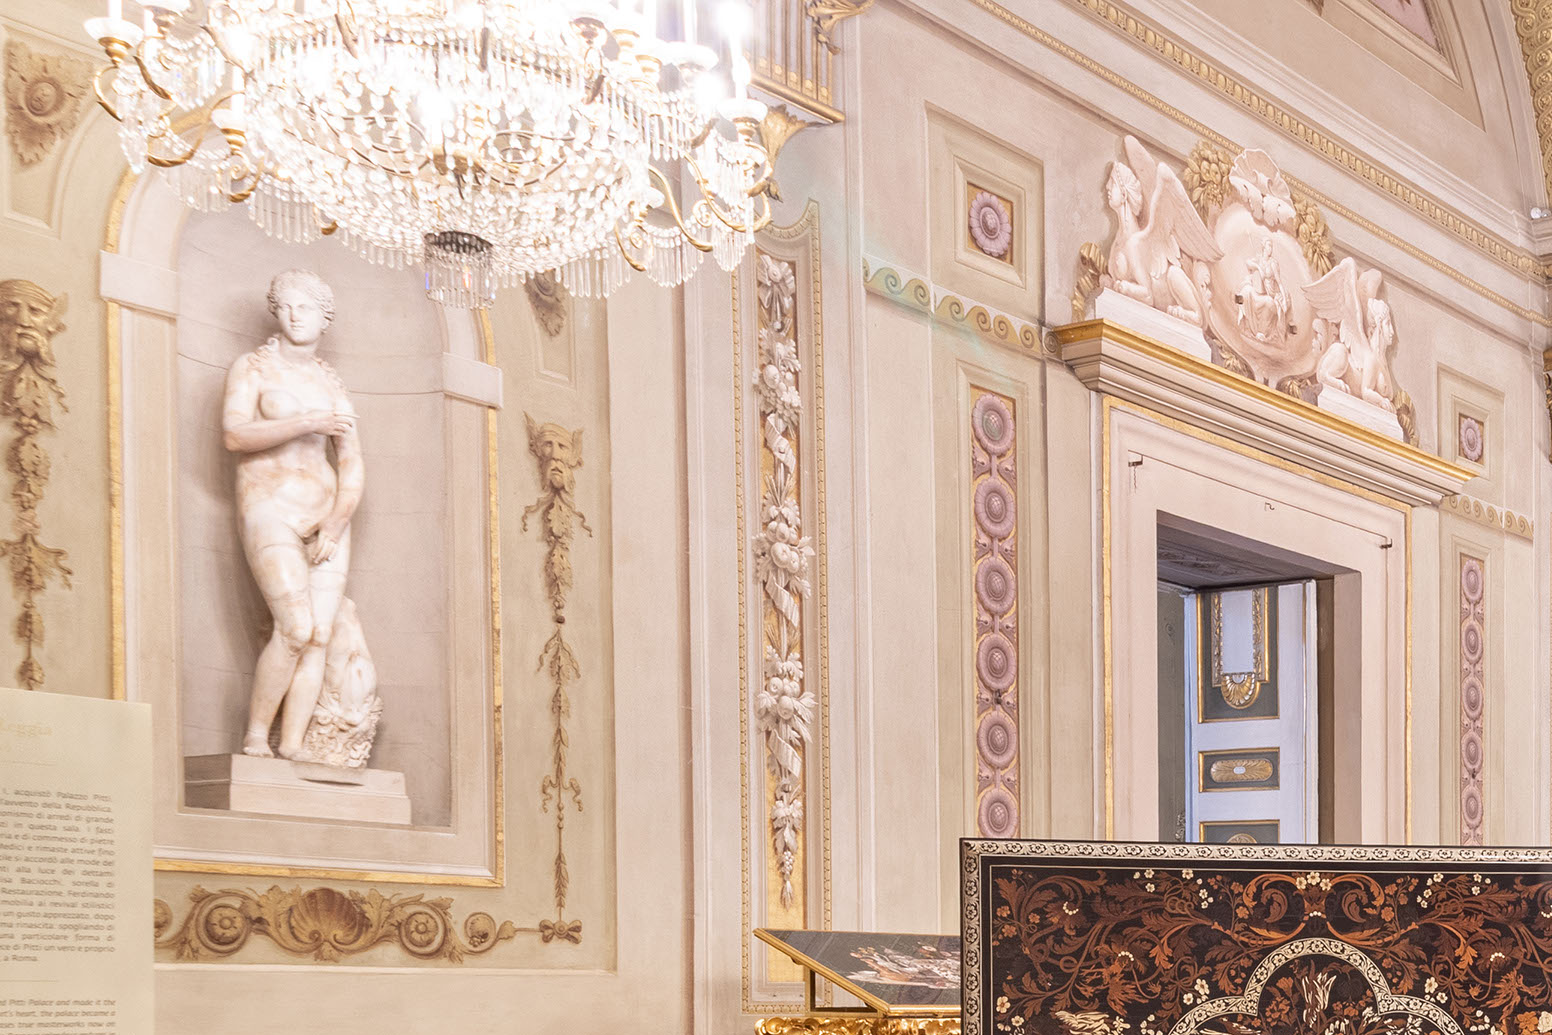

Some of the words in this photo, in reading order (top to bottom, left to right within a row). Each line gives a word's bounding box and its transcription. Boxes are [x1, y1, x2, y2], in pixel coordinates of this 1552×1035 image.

[57, 792, 88, 800] Palazzo
[32, 835, 77, 843] commesso
[90, 837, 114, 845] pietre
[36, 845, 68, 853] rimaste
[71, 847, 95, 855] attive
[68, 890, 115, 899] Ferdinando
[17, 911, 40, 919] gusto
[95, 913, 115, 921] dopo
[59, 923, 104, 931] spogliando
[22, 933, 69, 941] particolare
[84, 945, 115, 953] proprio
[55, 1010, 79, 1018] palace
